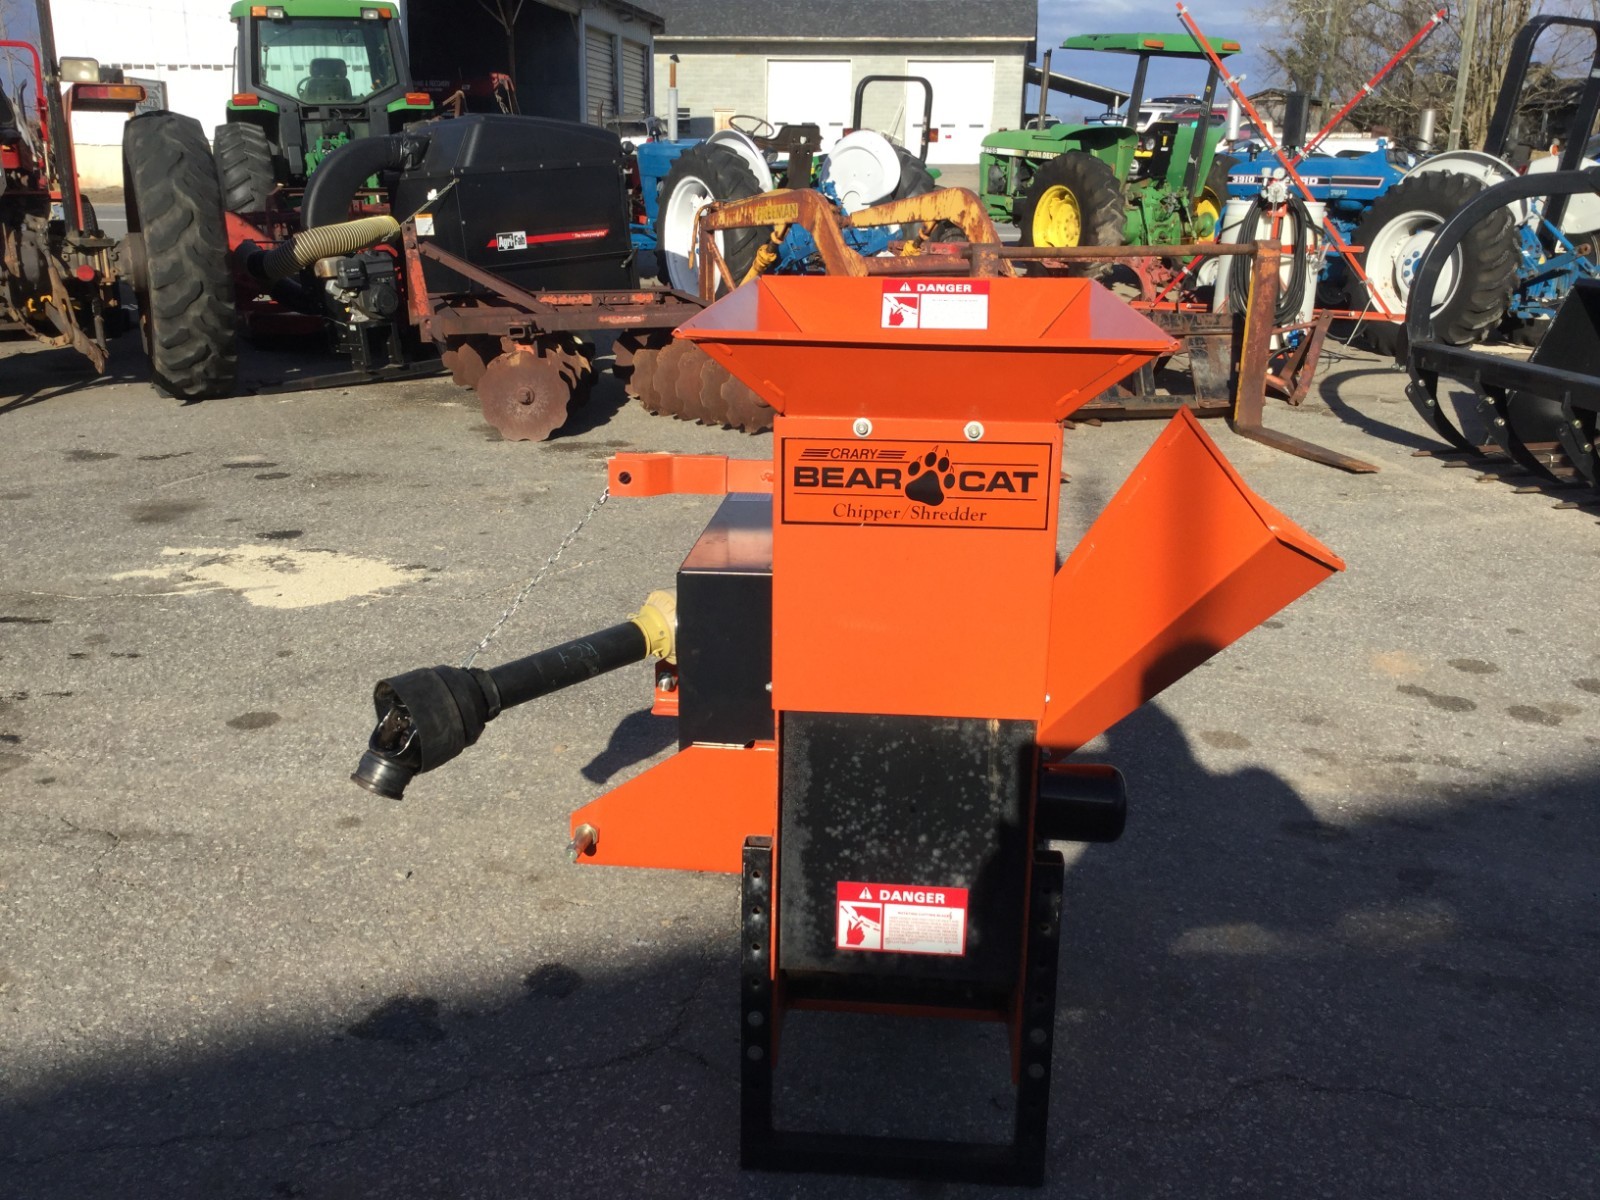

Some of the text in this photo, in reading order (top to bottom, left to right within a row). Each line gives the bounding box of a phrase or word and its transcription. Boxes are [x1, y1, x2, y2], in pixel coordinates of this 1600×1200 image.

[1027, 150, 1042, 158] JOHN
[1232, 176, 1255, 184] 3910
[917, 284, 972, 292] DANGER
[831, 448, 878, 459] CRARY
[794, 466, 1038, 493] BEAR CAT
[833, 503, 987, 521] Chipper/Shredder
[880, 890, 945, 904] DANGER
